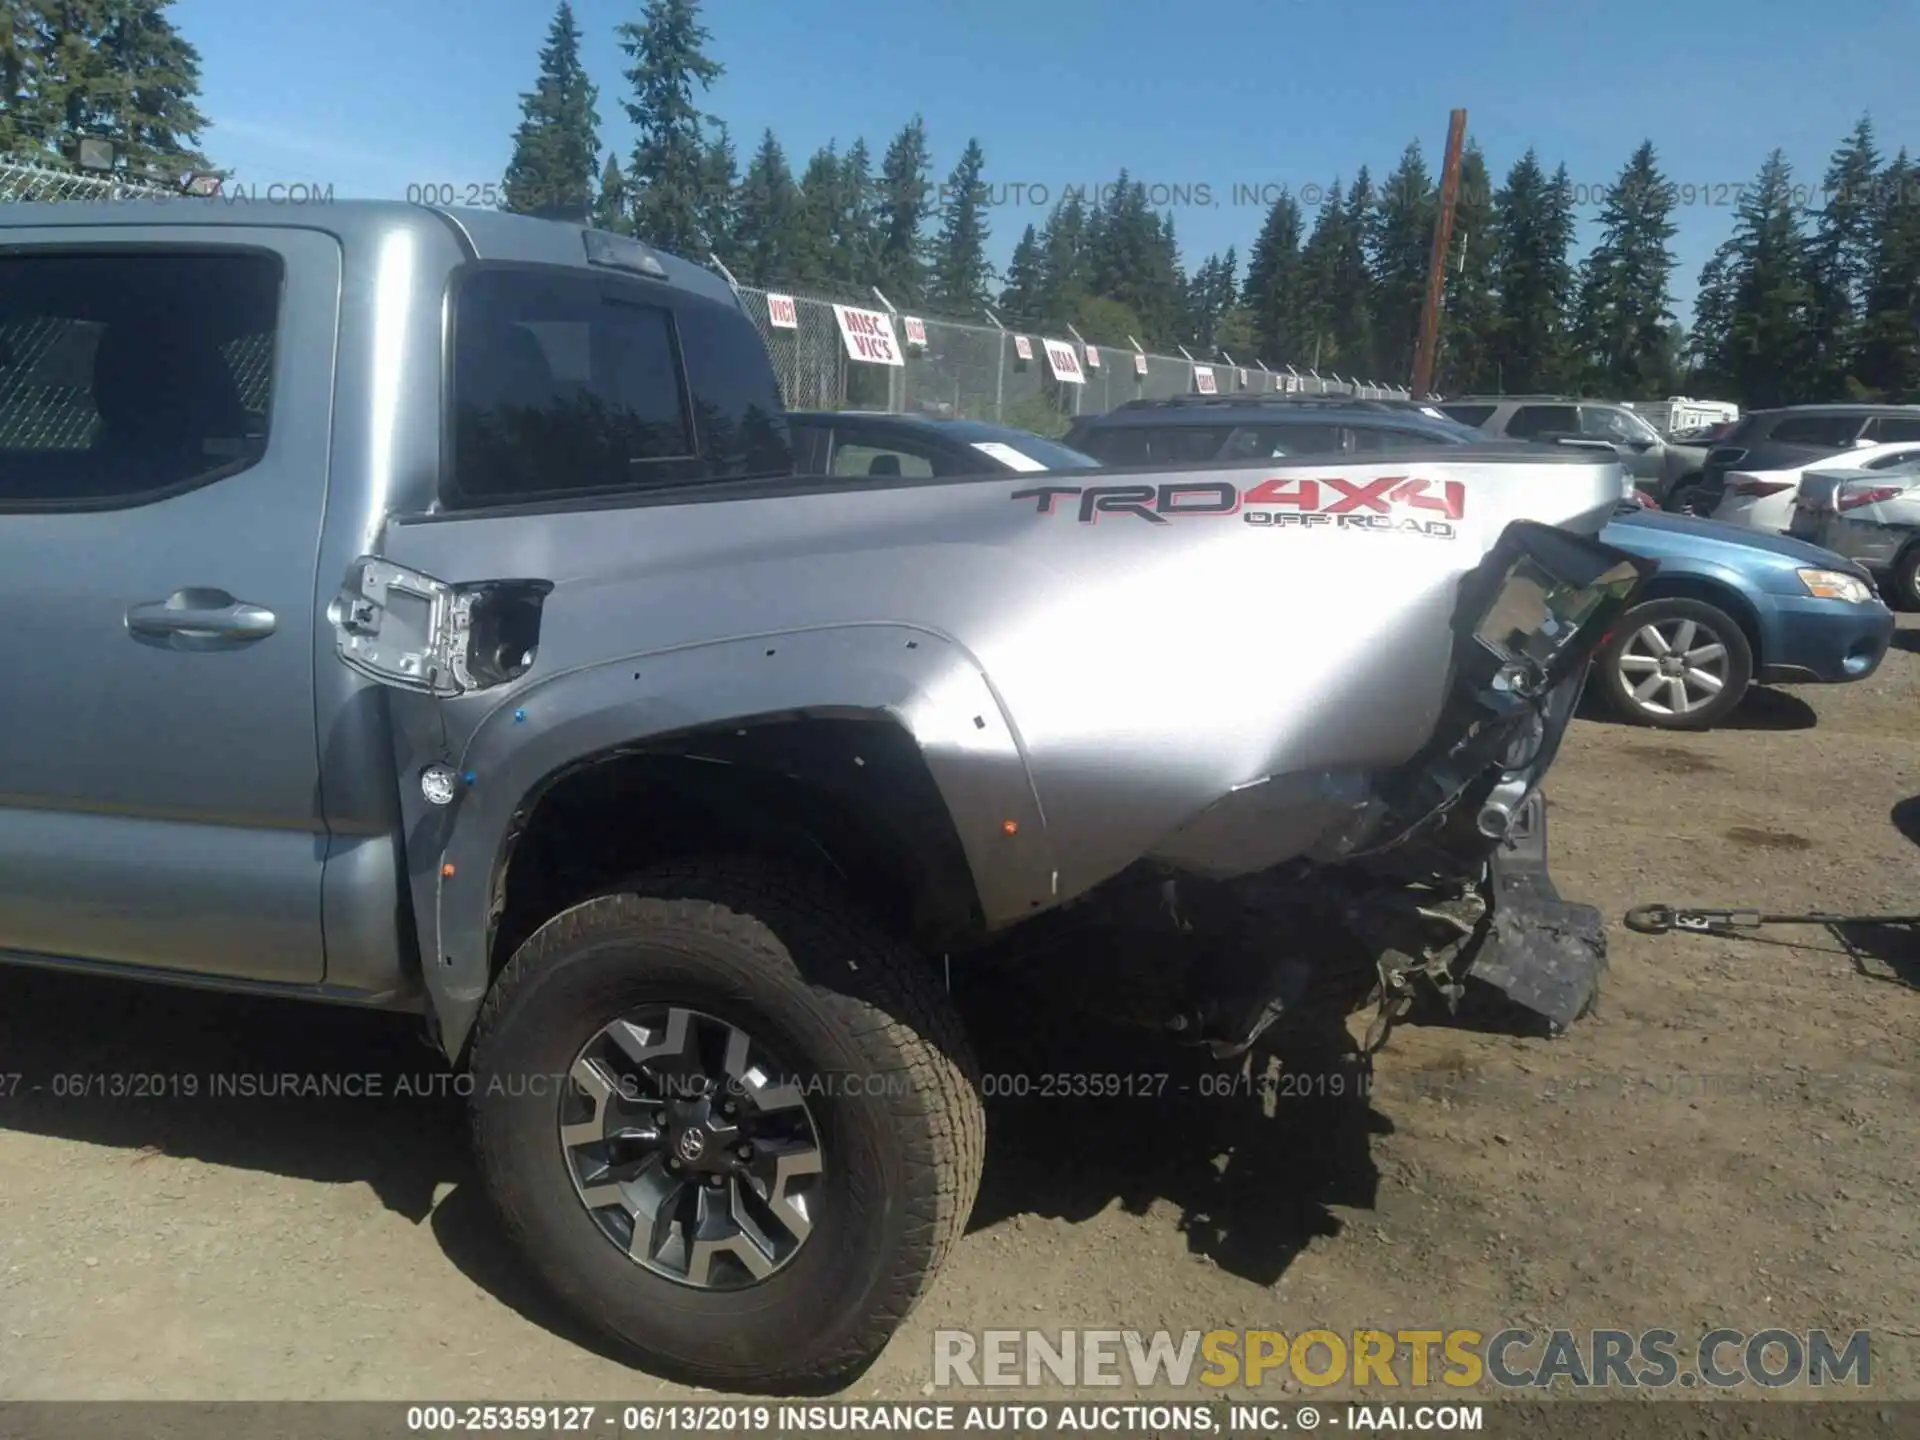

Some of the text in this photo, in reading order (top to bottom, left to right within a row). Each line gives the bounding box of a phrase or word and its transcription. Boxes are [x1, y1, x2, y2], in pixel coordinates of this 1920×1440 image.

[843, 310, 889, 337] MISC.
[853, 335, 893, 360] VIC'S
[1010, 481, 1241, 526] TRD
